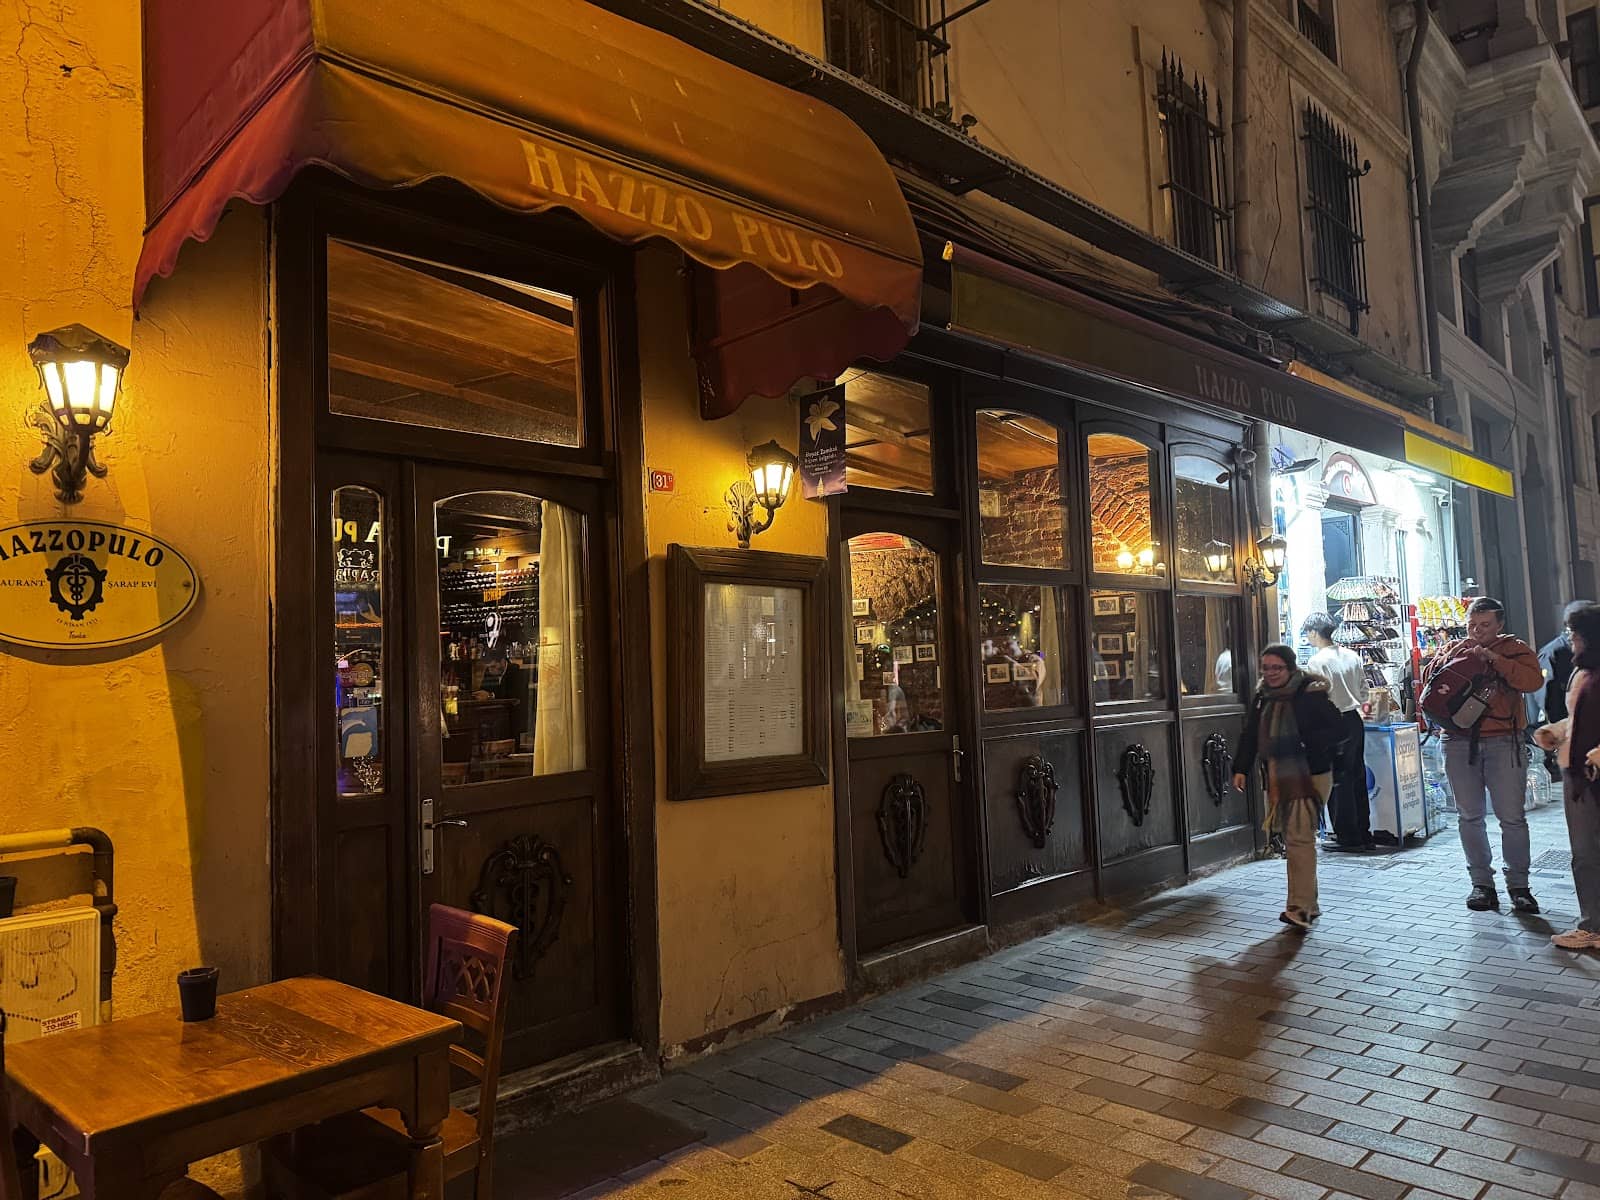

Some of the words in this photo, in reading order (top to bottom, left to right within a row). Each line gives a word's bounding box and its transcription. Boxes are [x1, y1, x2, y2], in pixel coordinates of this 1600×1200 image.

[519, 138, 713, 241] HAZZO
[732, 212, 844, 279] PULO
[1261, 386, 1297, 424] PULO
[41, 1012, 78, 1026] STRAIGHT
